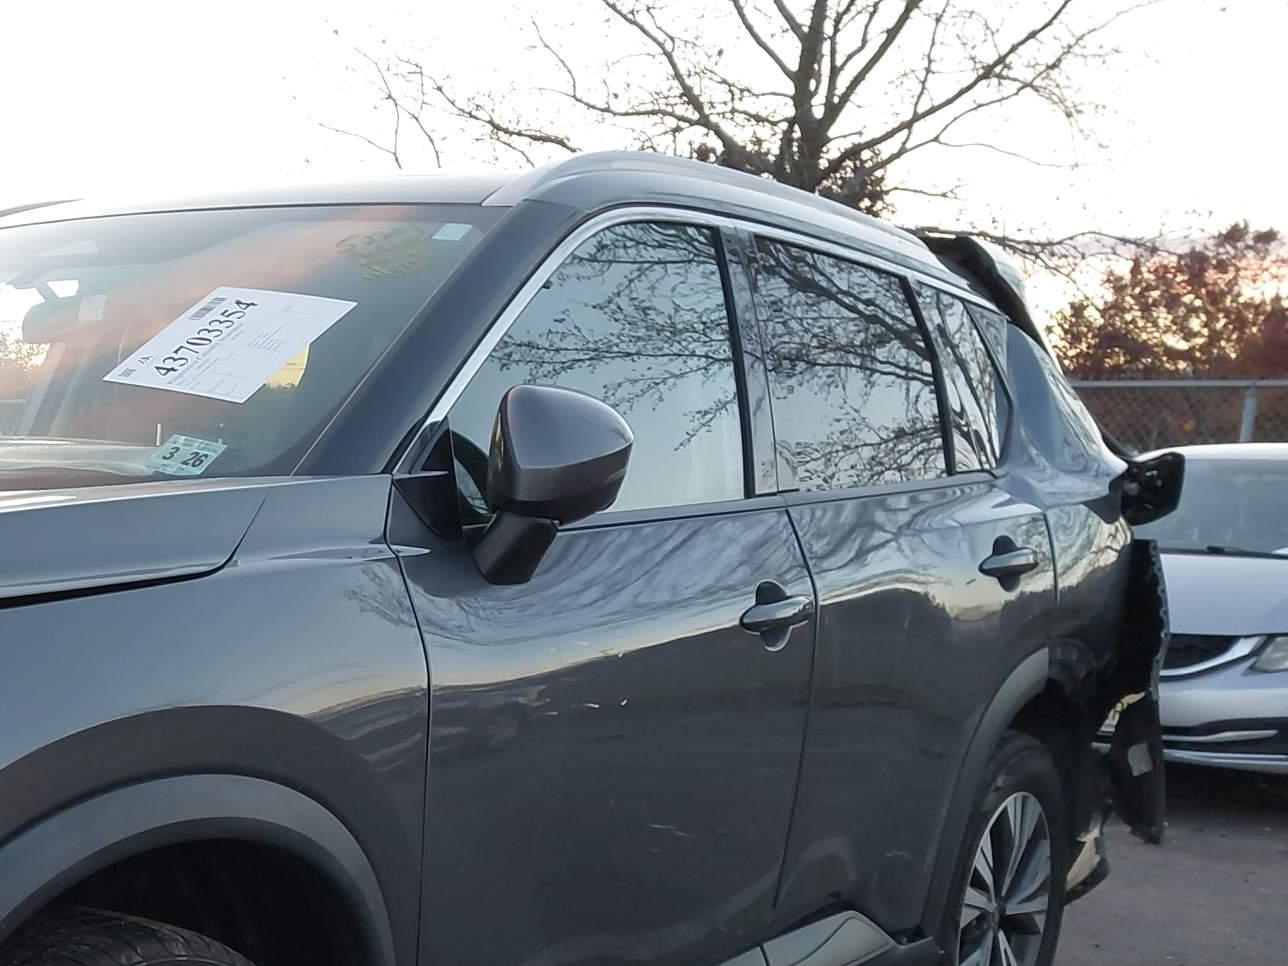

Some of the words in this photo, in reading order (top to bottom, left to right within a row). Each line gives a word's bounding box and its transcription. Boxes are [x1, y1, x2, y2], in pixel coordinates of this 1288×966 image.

[155, 299, 258, 378] 43703354
[162, 446, 180, 461] 3
[181, 451, 209, 468] 26
